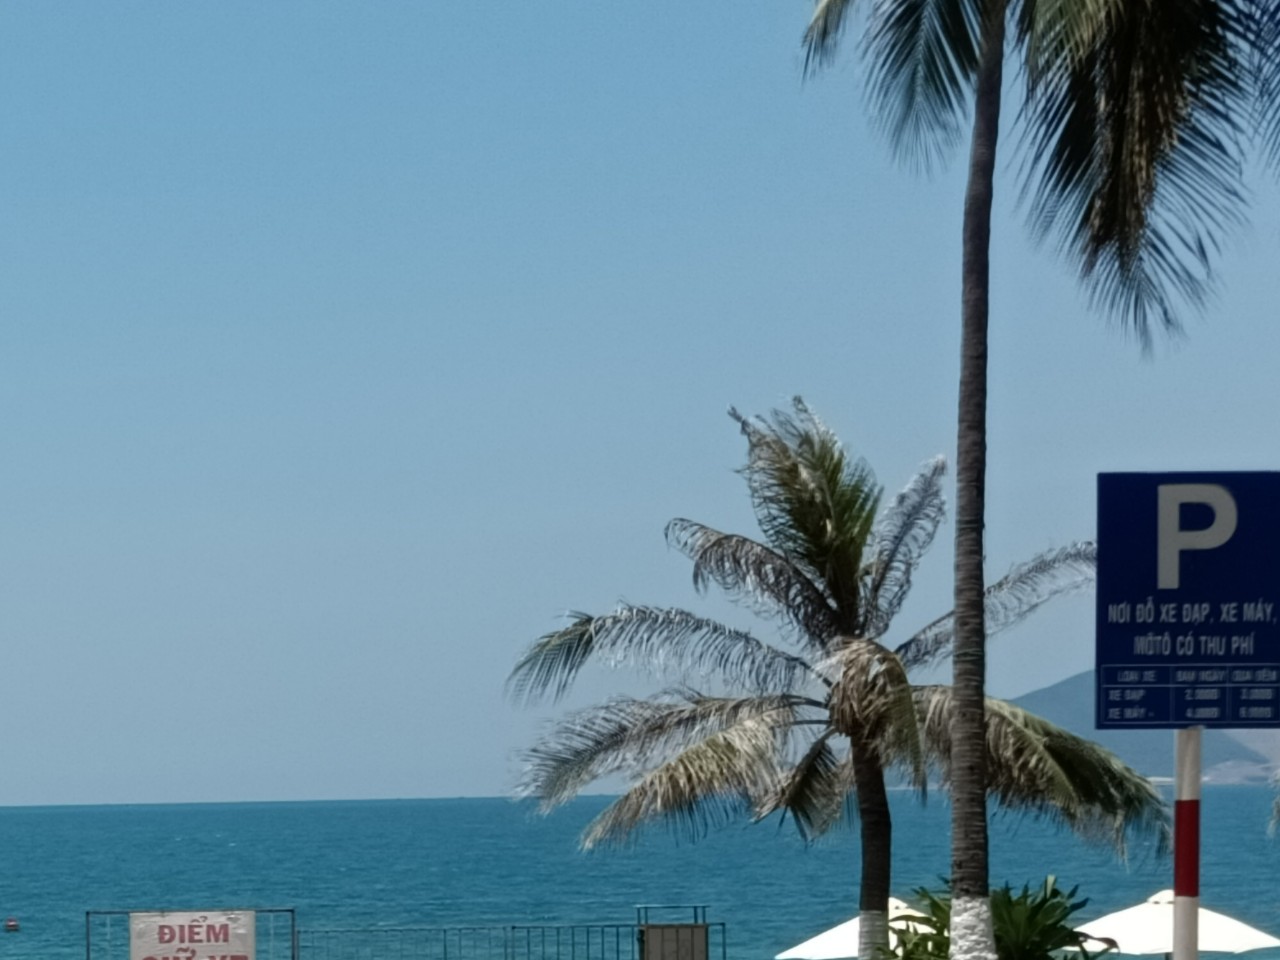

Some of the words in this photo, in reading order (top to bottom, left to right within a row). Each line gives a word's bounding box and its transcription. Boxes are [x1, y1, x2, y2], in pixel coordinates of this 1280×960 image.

[1157, 483, 1238, 589] P
[1108, 601, 1131, 623] NƠI
[1136, 596, 1155, 623] ĐỖ
[1159, 603, 1177, 623] XE
[1220, 603, 1239, 623] XE
[1176, 631, 1194, 656] CÓ
[1200, 636, 1226, 656] THU
[1231, 631, 1255, 656] PHÍ
[157, 916, 230, 944] ĐIỂM
